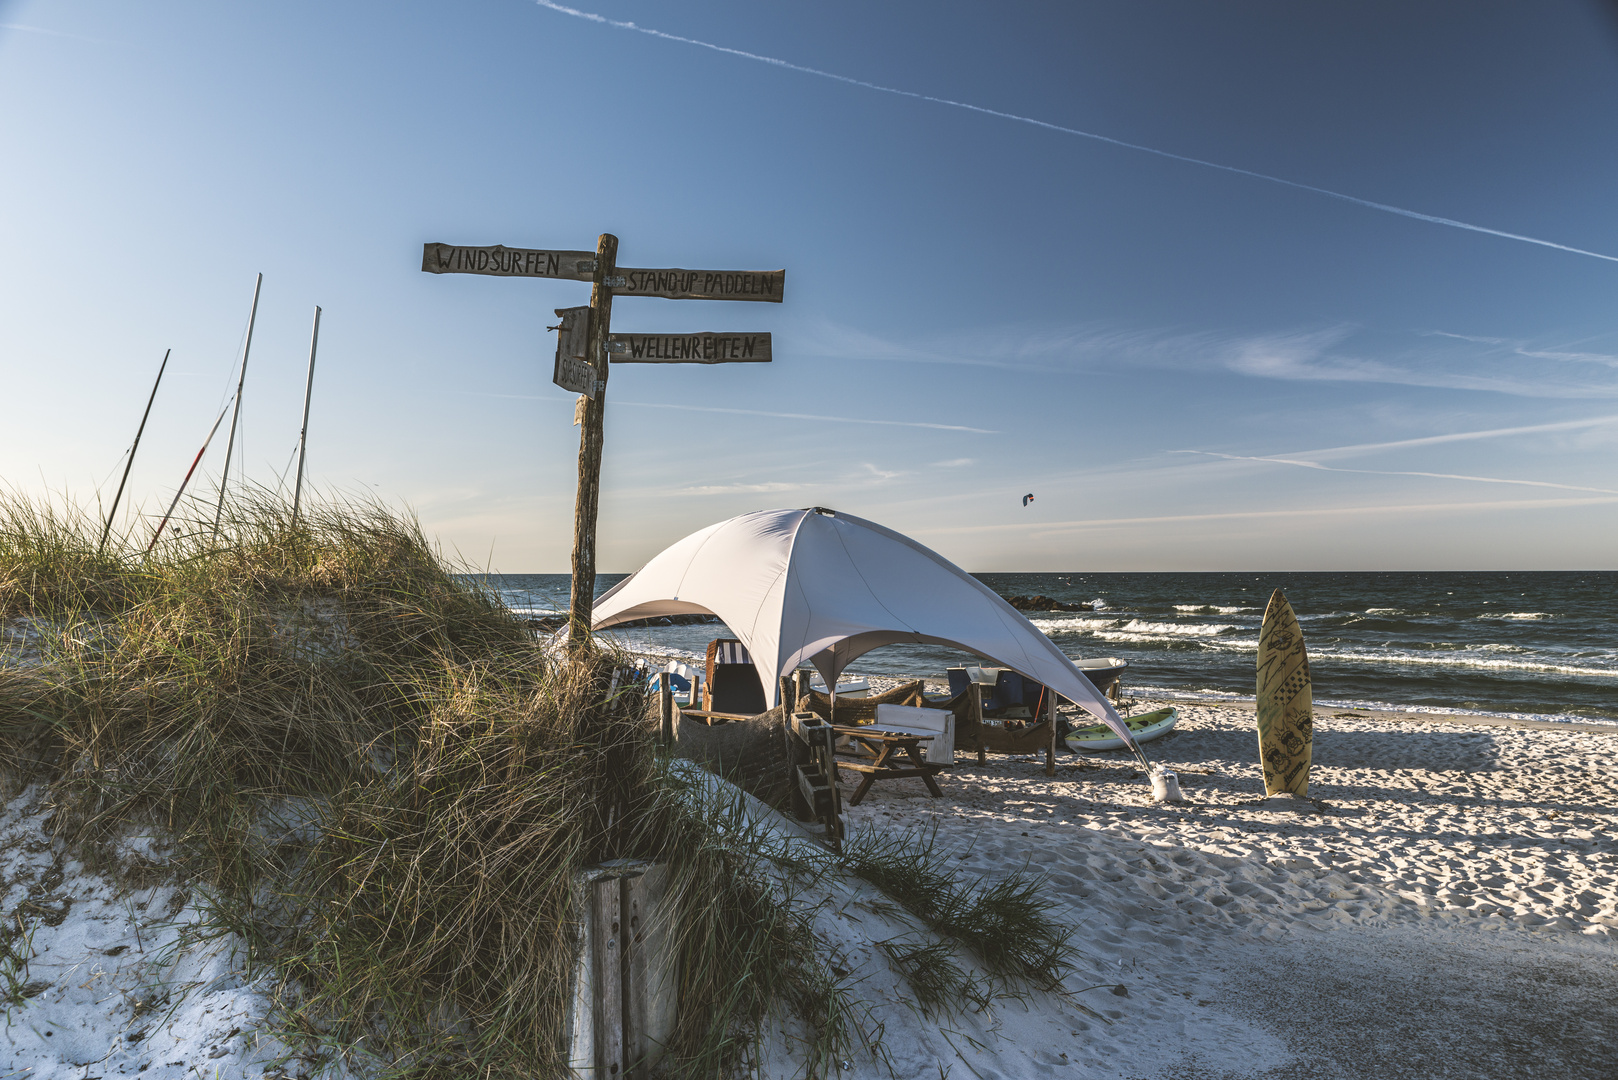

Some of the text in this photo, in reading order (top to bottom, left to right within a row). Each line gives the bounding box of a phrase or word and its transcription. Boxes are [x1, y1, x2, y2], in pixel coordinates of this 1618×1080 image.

[436, 248, 560, 276] WINDSURFEN
[628, 271, 774, 295] STAND-UP-PADDELN
[629, 336, 757, 360] WELLENREITEN
